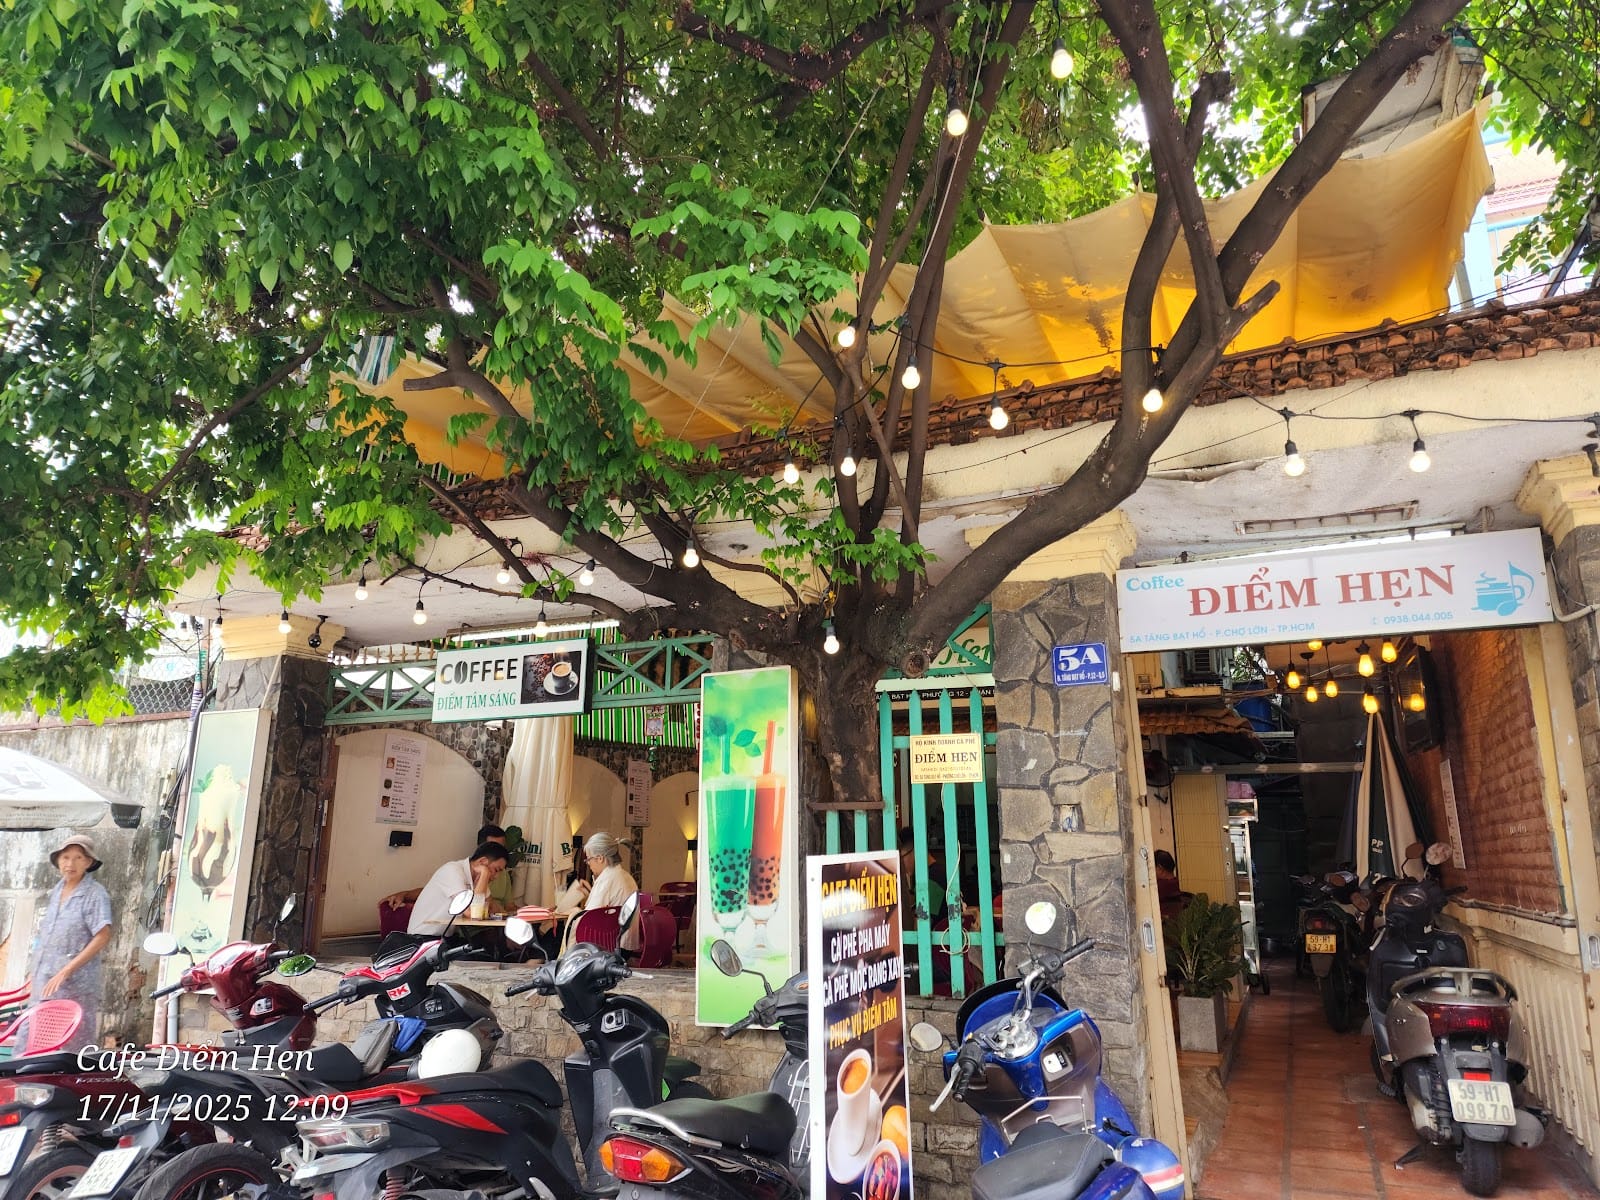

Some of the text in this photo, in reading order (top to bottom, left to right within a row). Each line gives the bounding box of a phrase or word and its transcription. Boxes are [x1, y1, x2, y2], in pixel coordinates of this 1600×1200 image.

[1126, 575, 1184, 592] Coffee
[1187, 564, 1455, 616] ĐIỂM HẸN
[1384, 611, 1454, 625] 0938.044.005
[1130, 635, 1142, 643] 5A
[1278, 622, 1315, 633] TP.HCM
[1058, 647, 1103, 671] 5A
[466, 691, 487, 708] TÂM
[489, 689, 517, 707] SÁNG
[952, 751, 978, 765] HẸN
[849, 866, 875, 912] ĐIỂM
[877, 873, 897, 913] HẸN
[831, 920, 891, 963] CÀ PHÊ PHA MÁY
[823, 976, 833, 1007] CÀ
[834, 969, 849, 1002] PHÊ
[868, 960, 887, 989] RANG
[888, 955, 903, 981] XAY
[830, 1017, 850, 1050] PHỤC
[851, 1012, 862, 1040] VỤ
[882, 996, 897, 1023] TÂM
[1458, 1083, 1499, 1102] 59-H1
[1456, 1101, 1511, 1121] 098.70
